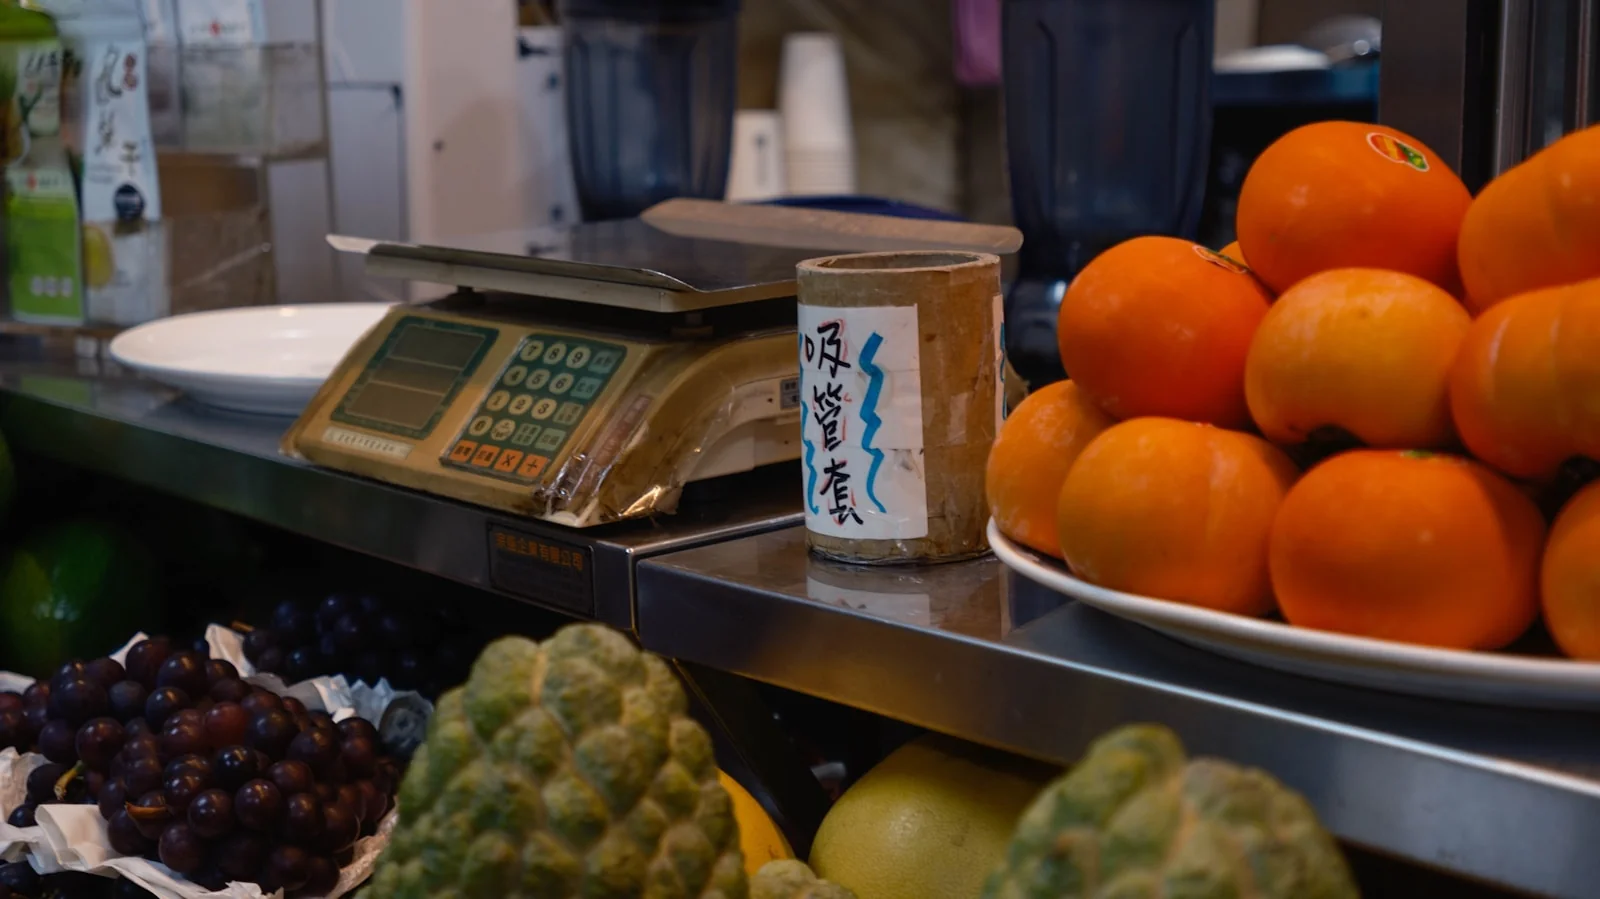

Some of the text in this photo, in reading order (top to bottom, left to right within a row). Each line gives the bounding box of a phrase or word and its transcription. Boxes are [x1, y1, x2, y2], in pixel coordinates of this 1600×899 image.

[572, 351, 584, 363] 9
[804, 319, 863, 526] 吸管套
